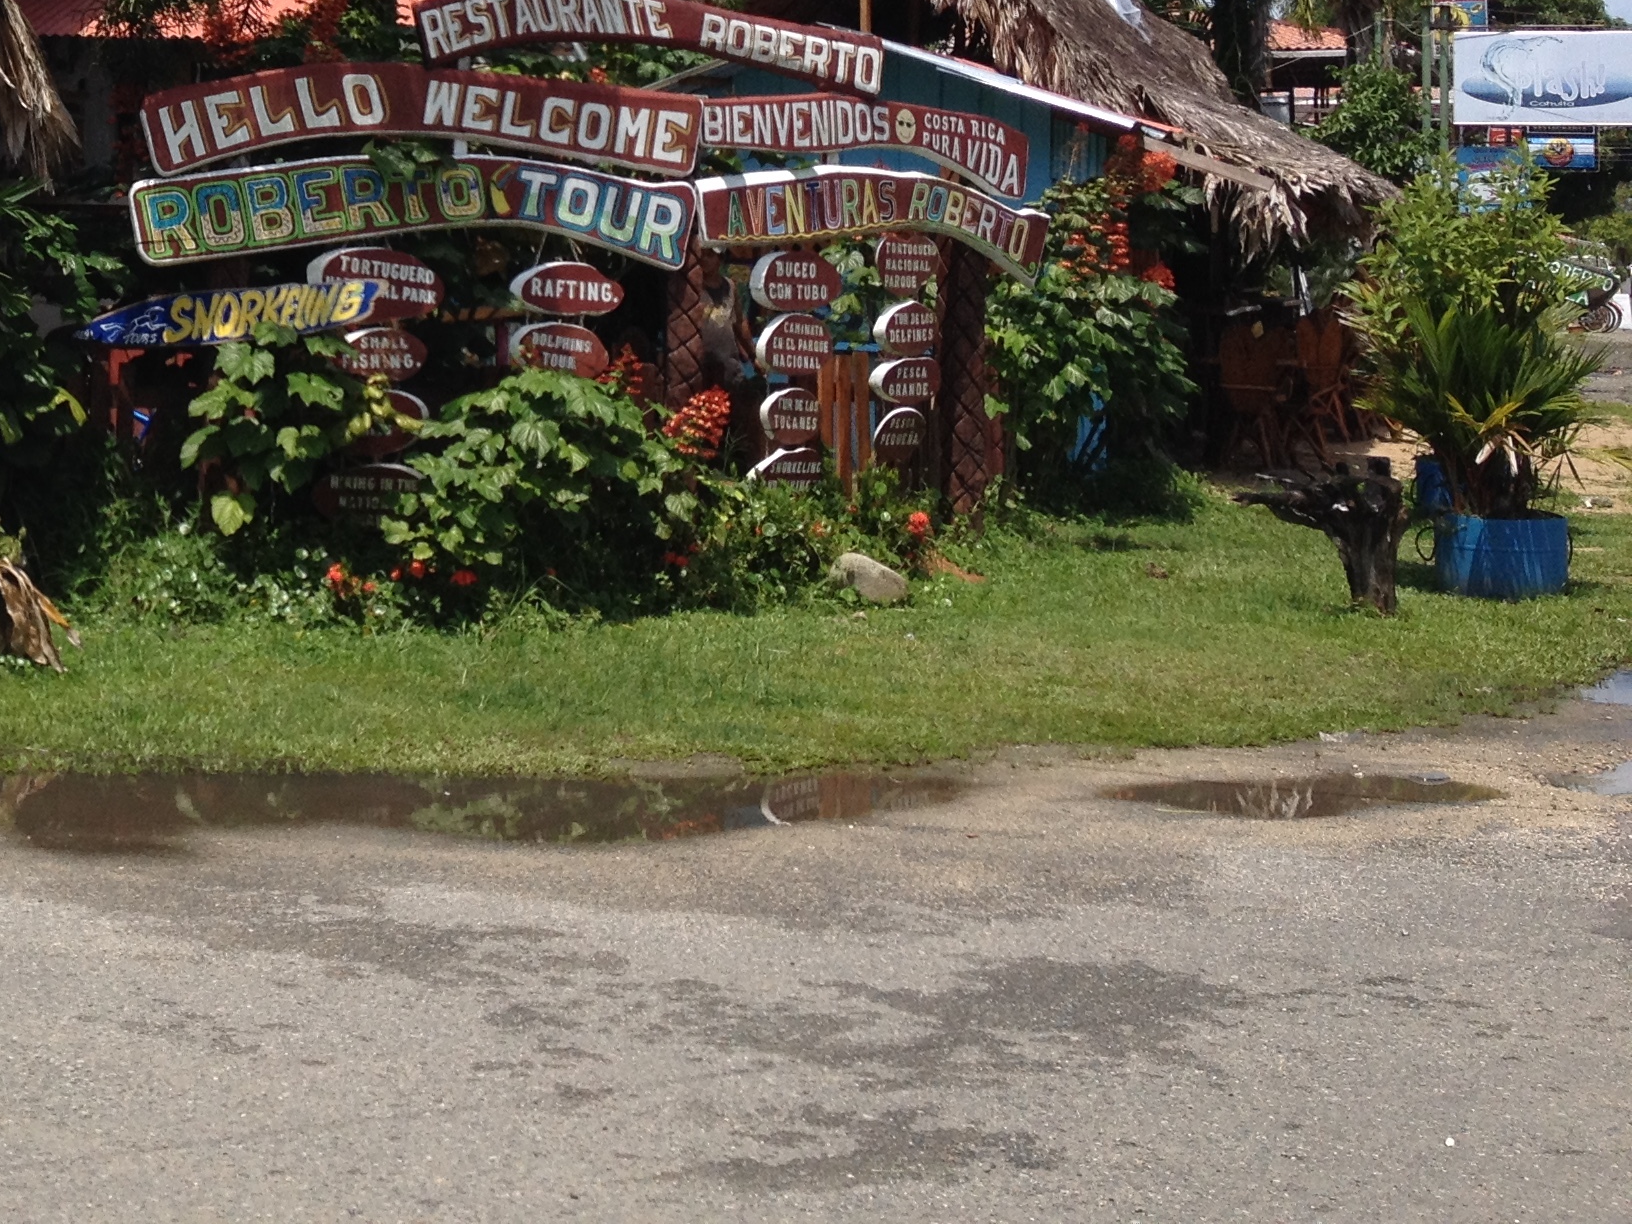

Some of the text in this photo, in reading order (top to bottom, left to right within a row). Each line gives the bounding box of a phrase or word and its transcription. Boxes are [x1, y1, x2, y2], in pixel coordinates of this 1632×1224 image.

[700, 13, 882, 95] ROBERTO
[158, 74, 691, 164] HELLO WELCOME
[704, 99, 890, 146] BIENVENIDOS
[924, 112, 1006, 145] COSTA RICA
[922, 131, 1019, 195] PURA VIDA
[137, 164, 686, 263] ROBERTO TOUR
[728, 179, 1031, 261] AVENTURAS ROBERTO
[340, 255, 435, 285] TORTUGUERO
[776, 260, 817, 278] BUCEO
[885, 258, 931, 271] NACIONAL
[531, 277, 618, 303] RAFTING.
[884, 274, 917, 288] PARQUE
[402, 286, 437, 304] PARK
[769, 283, 827, 300] CON TUBO
[783, 322, 824, 336] CAMINATA
[889, 328, 933, 342] DELFINES
[360, 336, 409, 349] SMALL
[542, 351, 577, 370] TOUR
[773, 354, 821, 369] NACIONAL
[897, 367, 927, 378] PESCA
[774, 415, 818, 430] TUCANES
